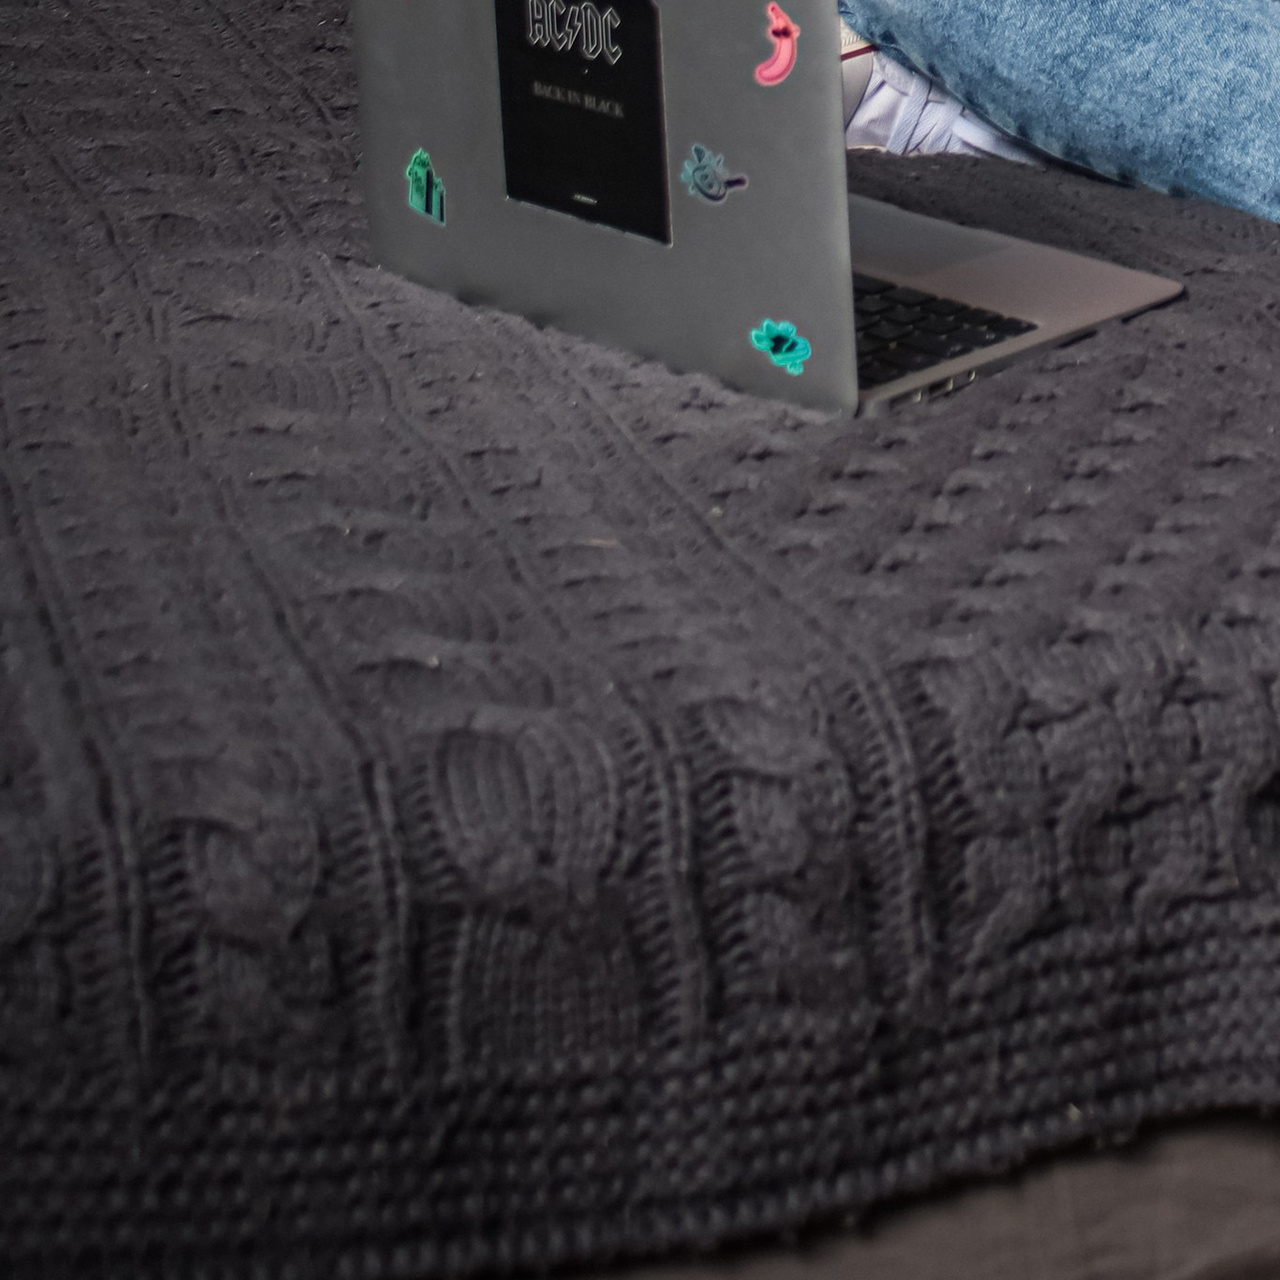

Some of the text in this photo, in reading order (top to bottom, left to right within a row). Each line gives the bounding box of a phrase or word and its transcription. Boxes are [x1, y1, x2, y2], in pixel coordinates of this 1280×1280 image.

[532, 80, 625, 119] BACK IN BLACK
